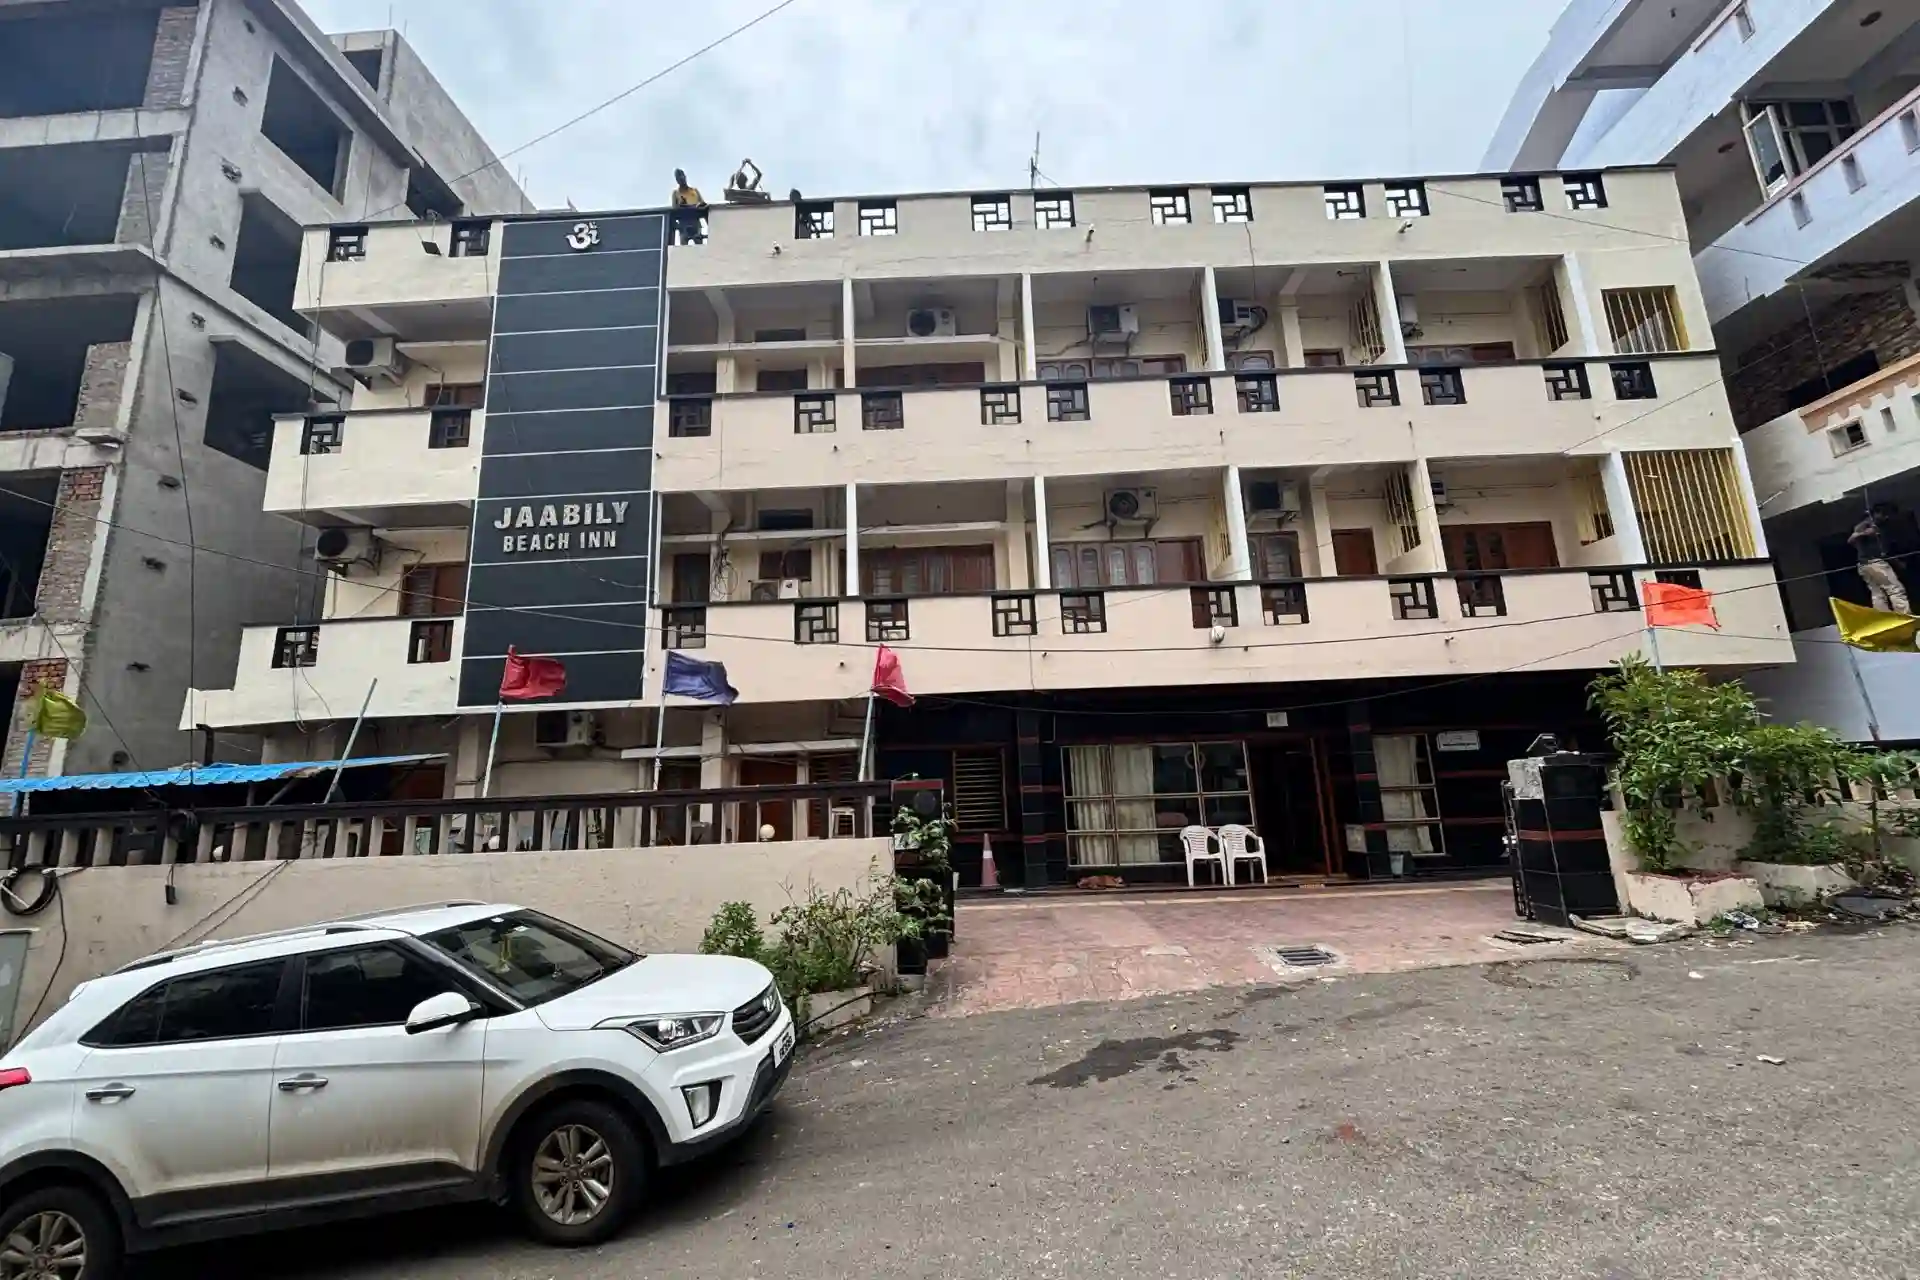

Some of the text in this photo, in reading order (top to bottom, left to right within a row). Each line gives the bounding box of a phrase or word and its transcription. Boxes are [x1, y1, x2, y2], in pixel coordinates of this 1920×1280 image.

[494, 501, 629, 529] JAABILY
[503, 530, 617, 552] BEACH INN
